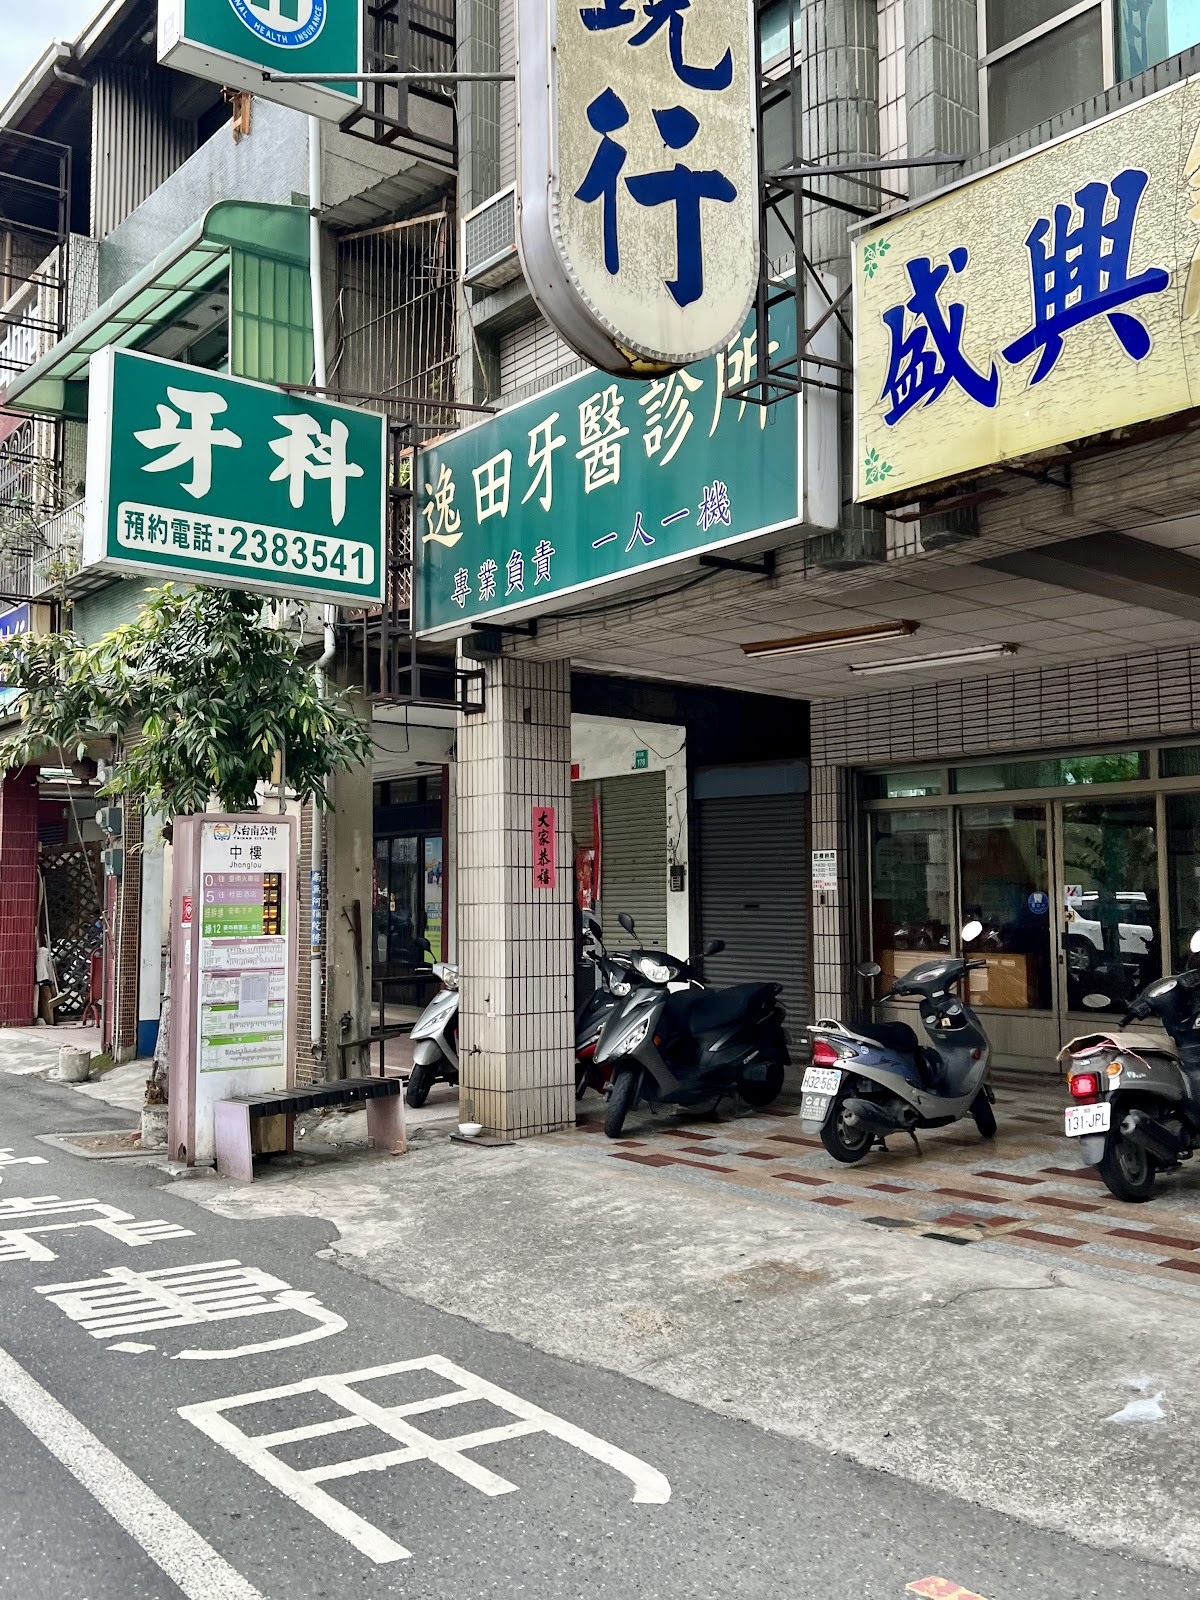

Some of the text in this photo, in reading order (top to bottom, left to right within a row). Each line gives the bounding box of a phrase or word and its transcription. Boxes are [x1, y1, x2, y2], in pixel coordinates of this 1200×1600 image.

[253, 22, 288, 43] HEALTH
[294, 5, 323, 43] INSURANCE
[880, 168, 1171, 427] 盛興
[422, 314, 779, 548] 逸田牙醫診所
[132, 385, 365, 527] 牙科
[450, 480, 733, 608] 專業負責 一人一機
[232, 824, 278, 837] 大台南公車
[229, 845, 262, 860] 中樓
[537, 810, 551, 885] 大家恭禧
[229, 861, 262, 870] Jhonglou
[205, 890, 215, 903] 5
[802, 1075, 839, 1091] H32-563
[1067, 1112, 1108, 1132] 131-JPL
